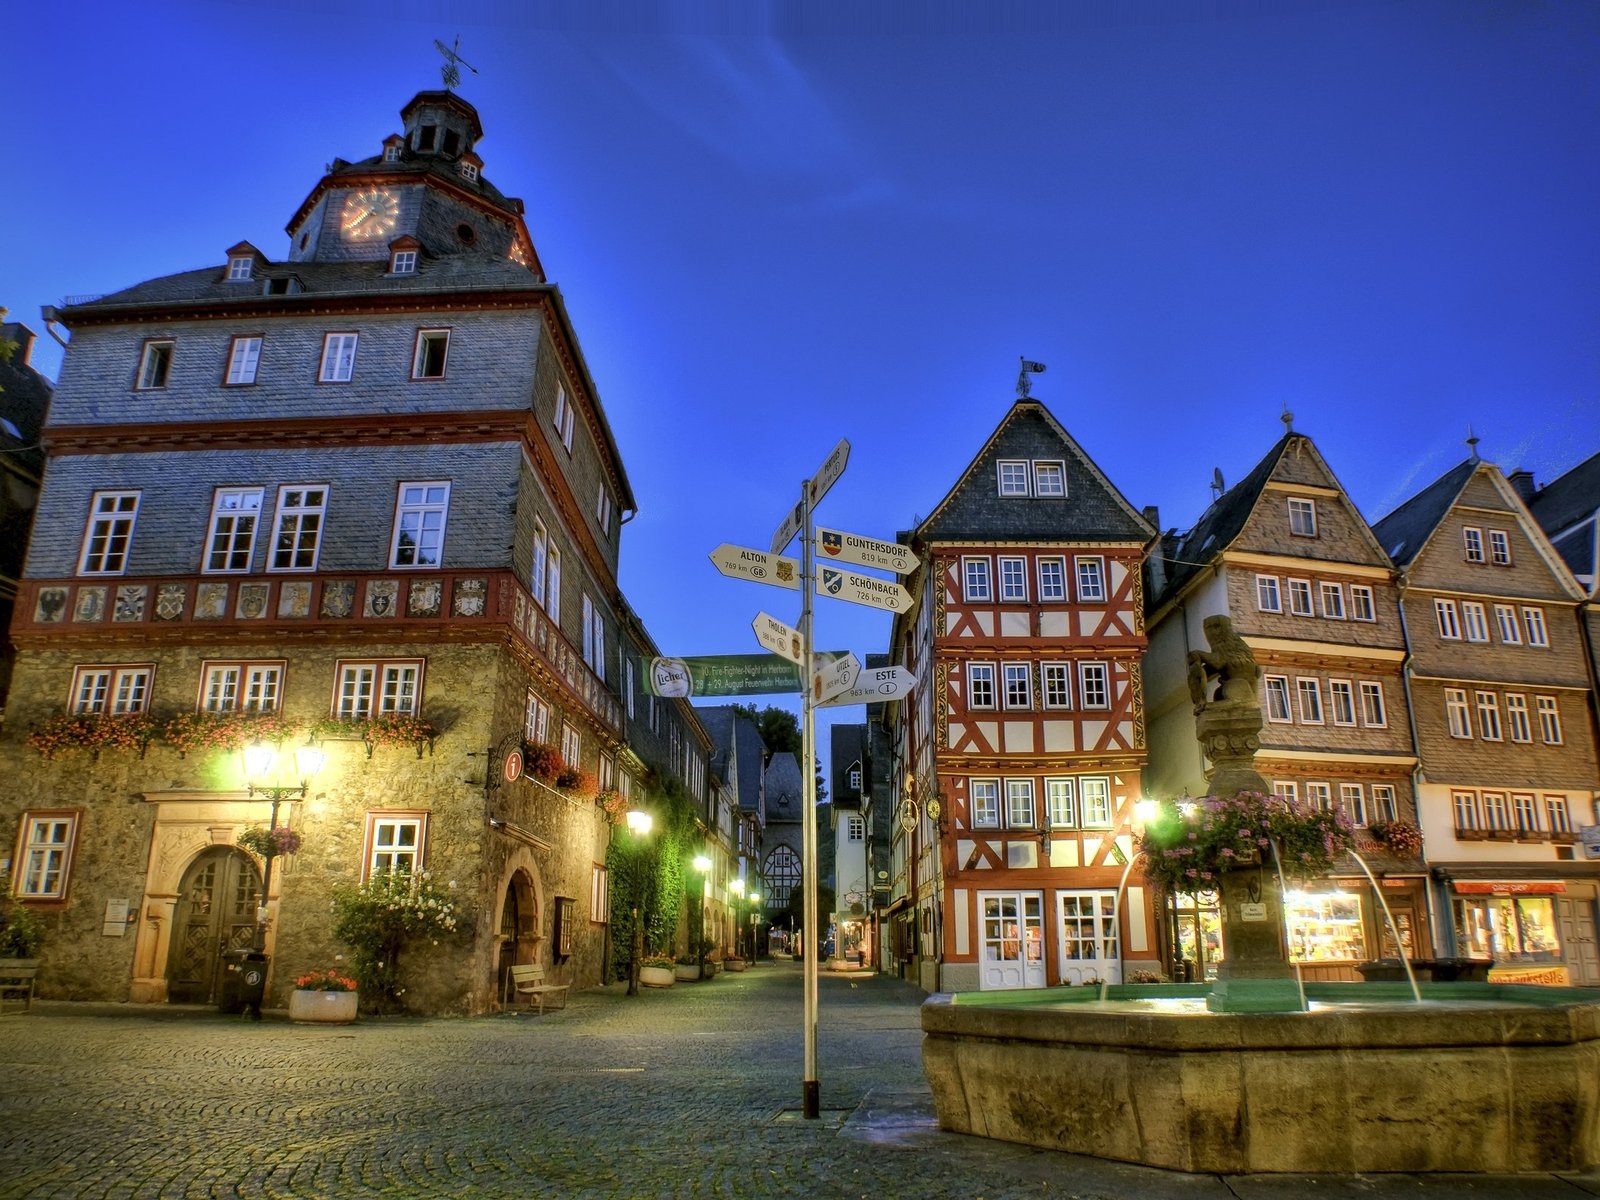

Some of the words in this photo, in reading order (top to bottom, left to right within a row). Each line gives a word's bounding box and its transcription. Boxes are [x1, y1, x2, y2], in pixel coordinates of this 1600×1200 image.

[846, 536, 908, 557] GUNTERSDORF
[740, 551, 767, 564] ALTON
[861, 552, 875, 562] 819
[877, 555, 888, 564] km
[897, 559, 902, 567] A
[725, 562, 736, 570] 769
[738, 564, 748, 572] km
[753, 568, 764, 577] GB
[850, 576, 899, 596] SCHÖNBACH
[856, 590, 870, 600] 726
[872, 594, 882, 603] km
[768, 619, 787, 637] THOLEN
[837, 660, 850, 672] UTIEL
[657, 671, 685, 686] Licher
[876, 670, 897, 680] ESTE
[865, 687, 875, 695] km
